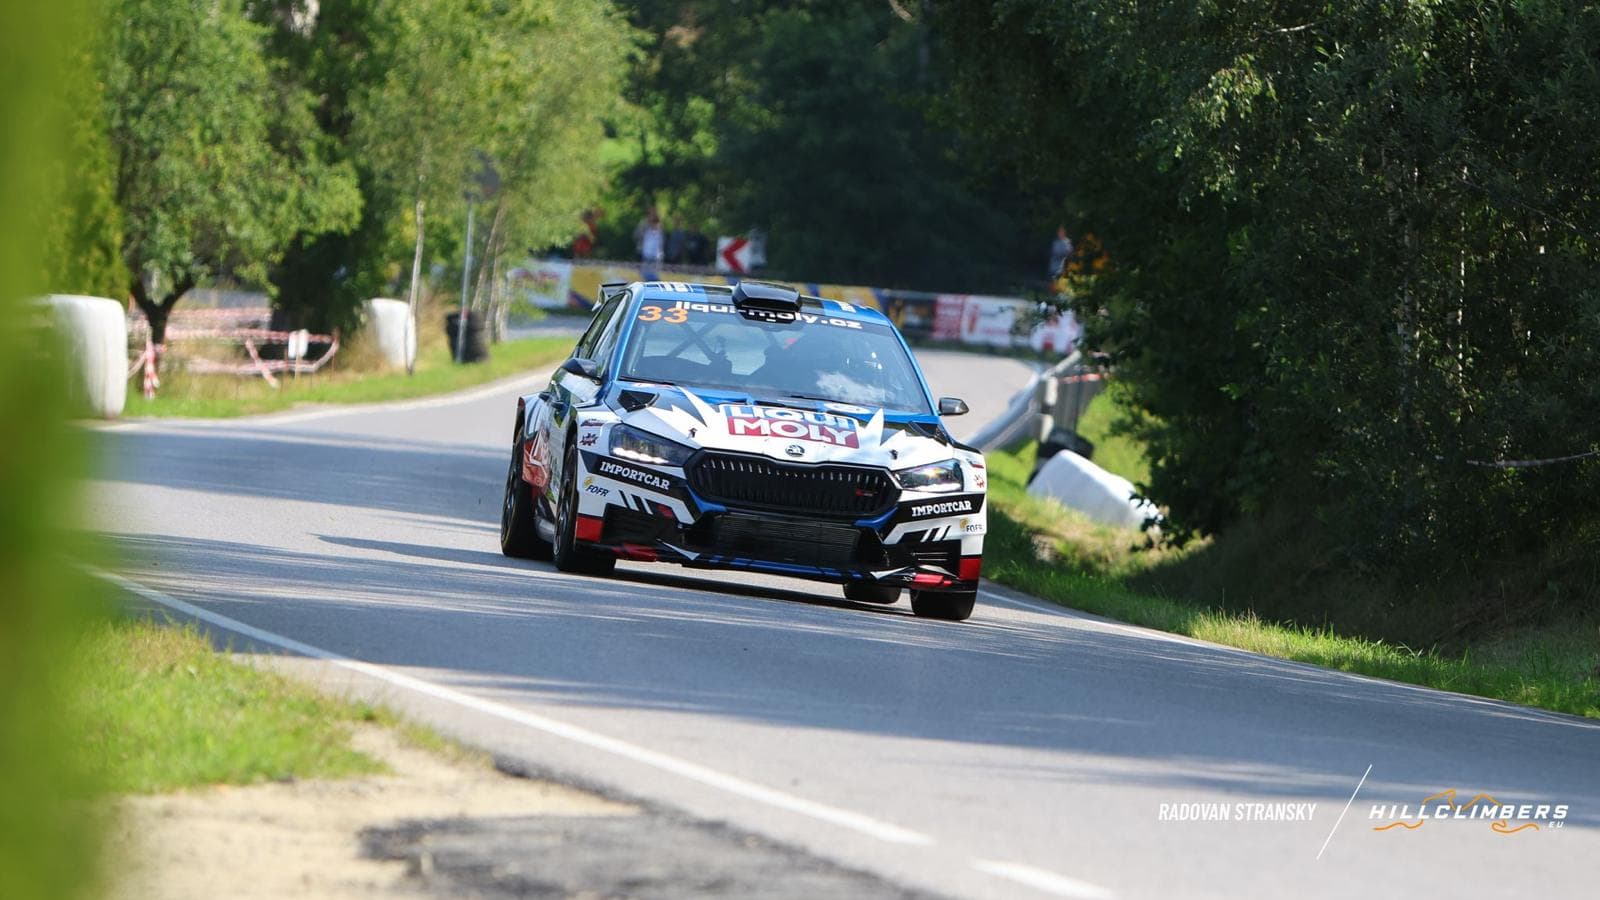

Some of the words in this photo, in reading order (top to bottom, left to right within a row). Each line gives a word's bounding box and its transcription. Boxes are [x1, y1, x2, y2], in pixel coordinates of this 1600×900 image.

[638, 305, 689, 325] 33
[675, 301, 863, 330] liqui-moly.cz
[728, 405, 850, 430] LIQUI
[733, 418, 855, 445] MOLY
[600, 461, 671, 490] IMPORTCAR
[585, 484, 610, 498] FOFR
[911, 500, 973, 517] IMPORTCAR
